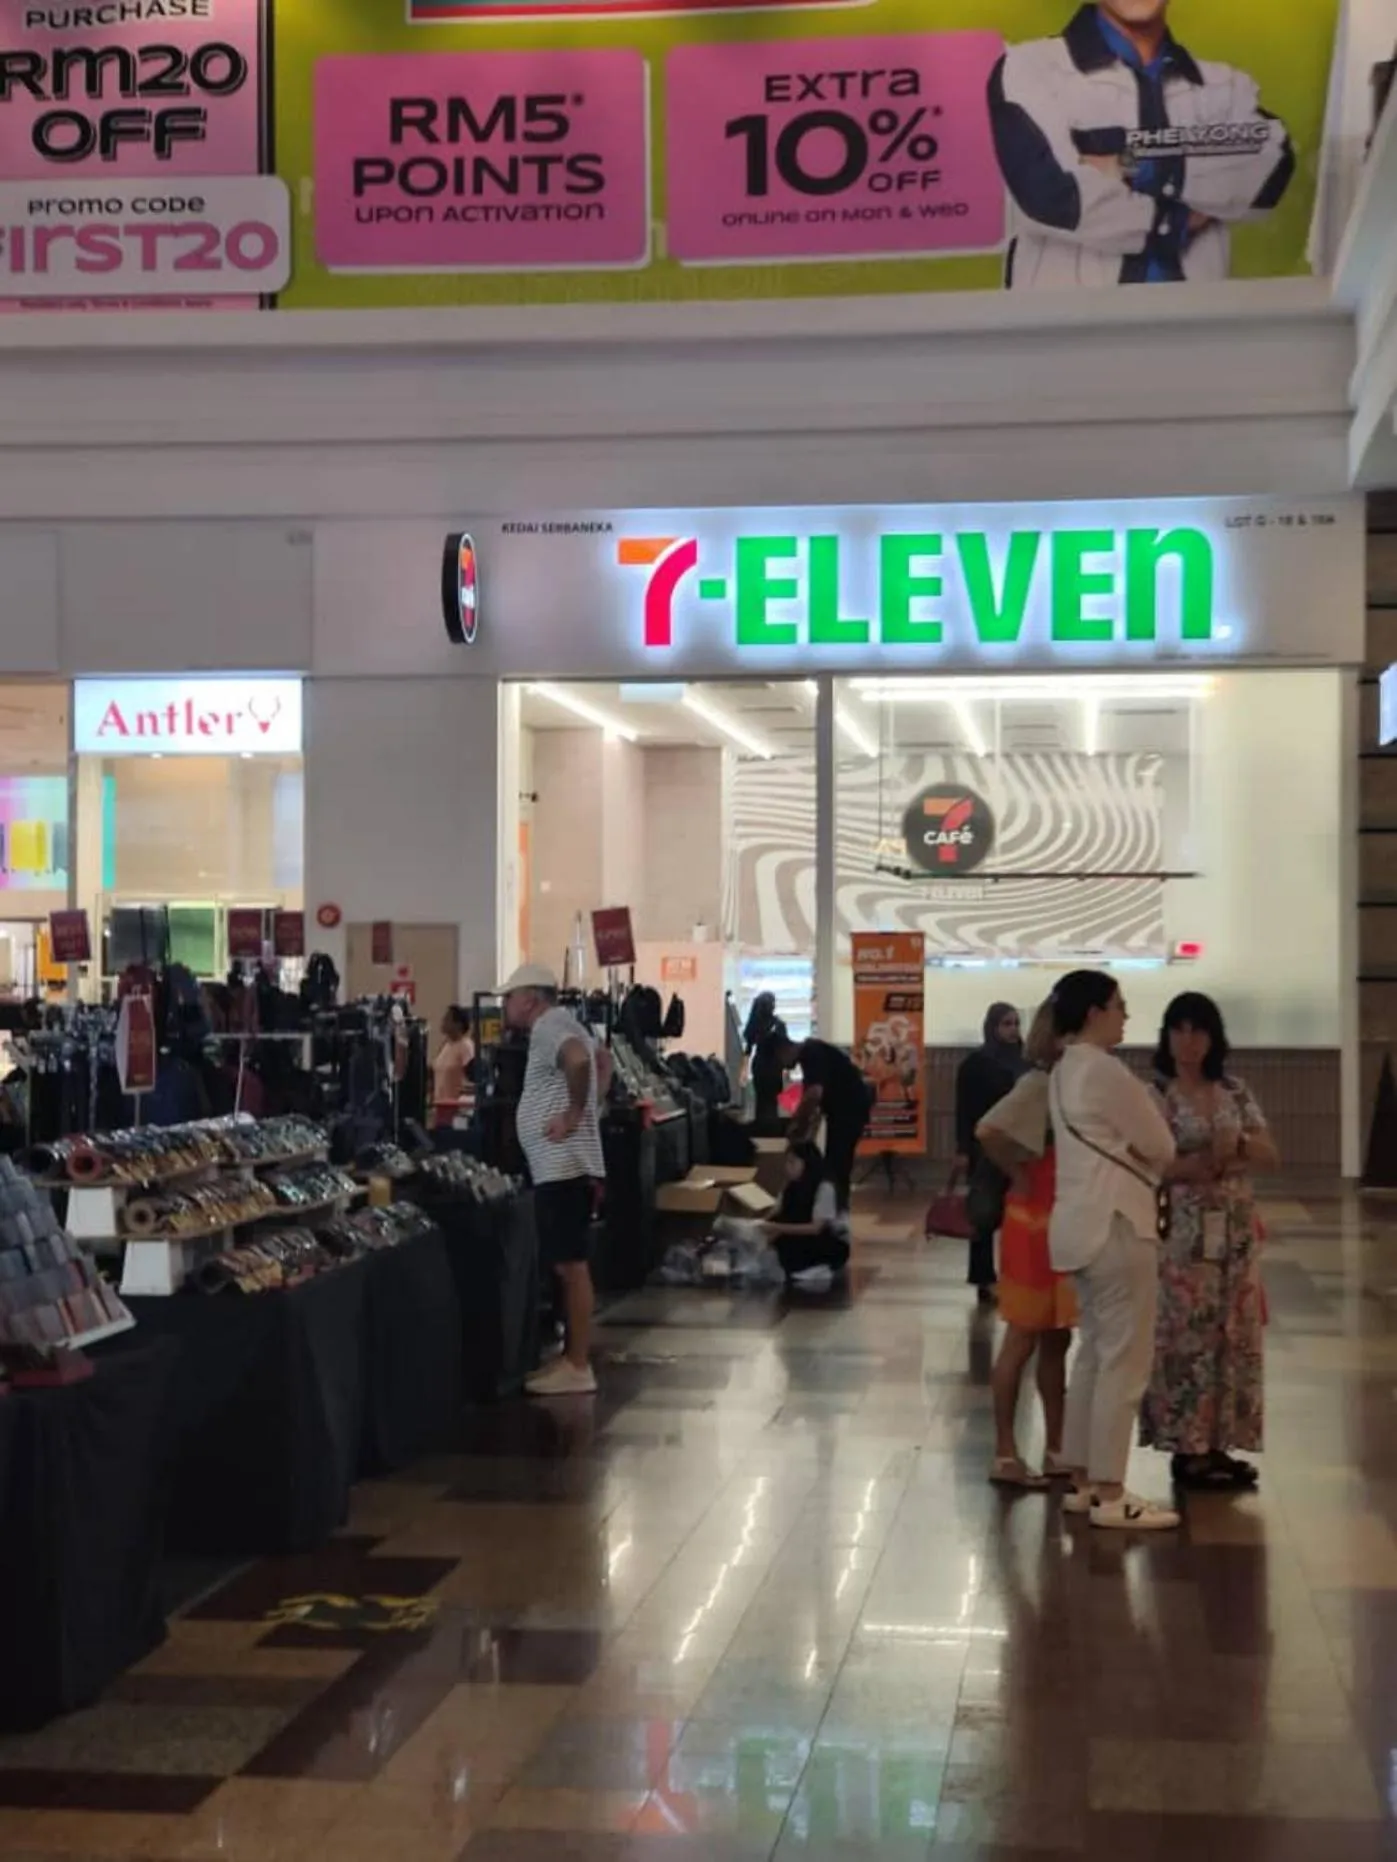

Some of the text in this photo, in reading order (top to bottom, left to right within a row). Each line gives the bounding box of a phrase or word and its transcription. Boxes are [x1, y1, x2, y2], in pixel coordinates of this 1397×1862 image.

[26, 0, 209, 28] PURCHASE
[32, 107, 207, 162] OFF
[353, 153, 606, 198] POINTS
[868, 169, 942, 193] OFF
[900, 206, 913, 219] &
[97, 697, 243, 737] Antler
